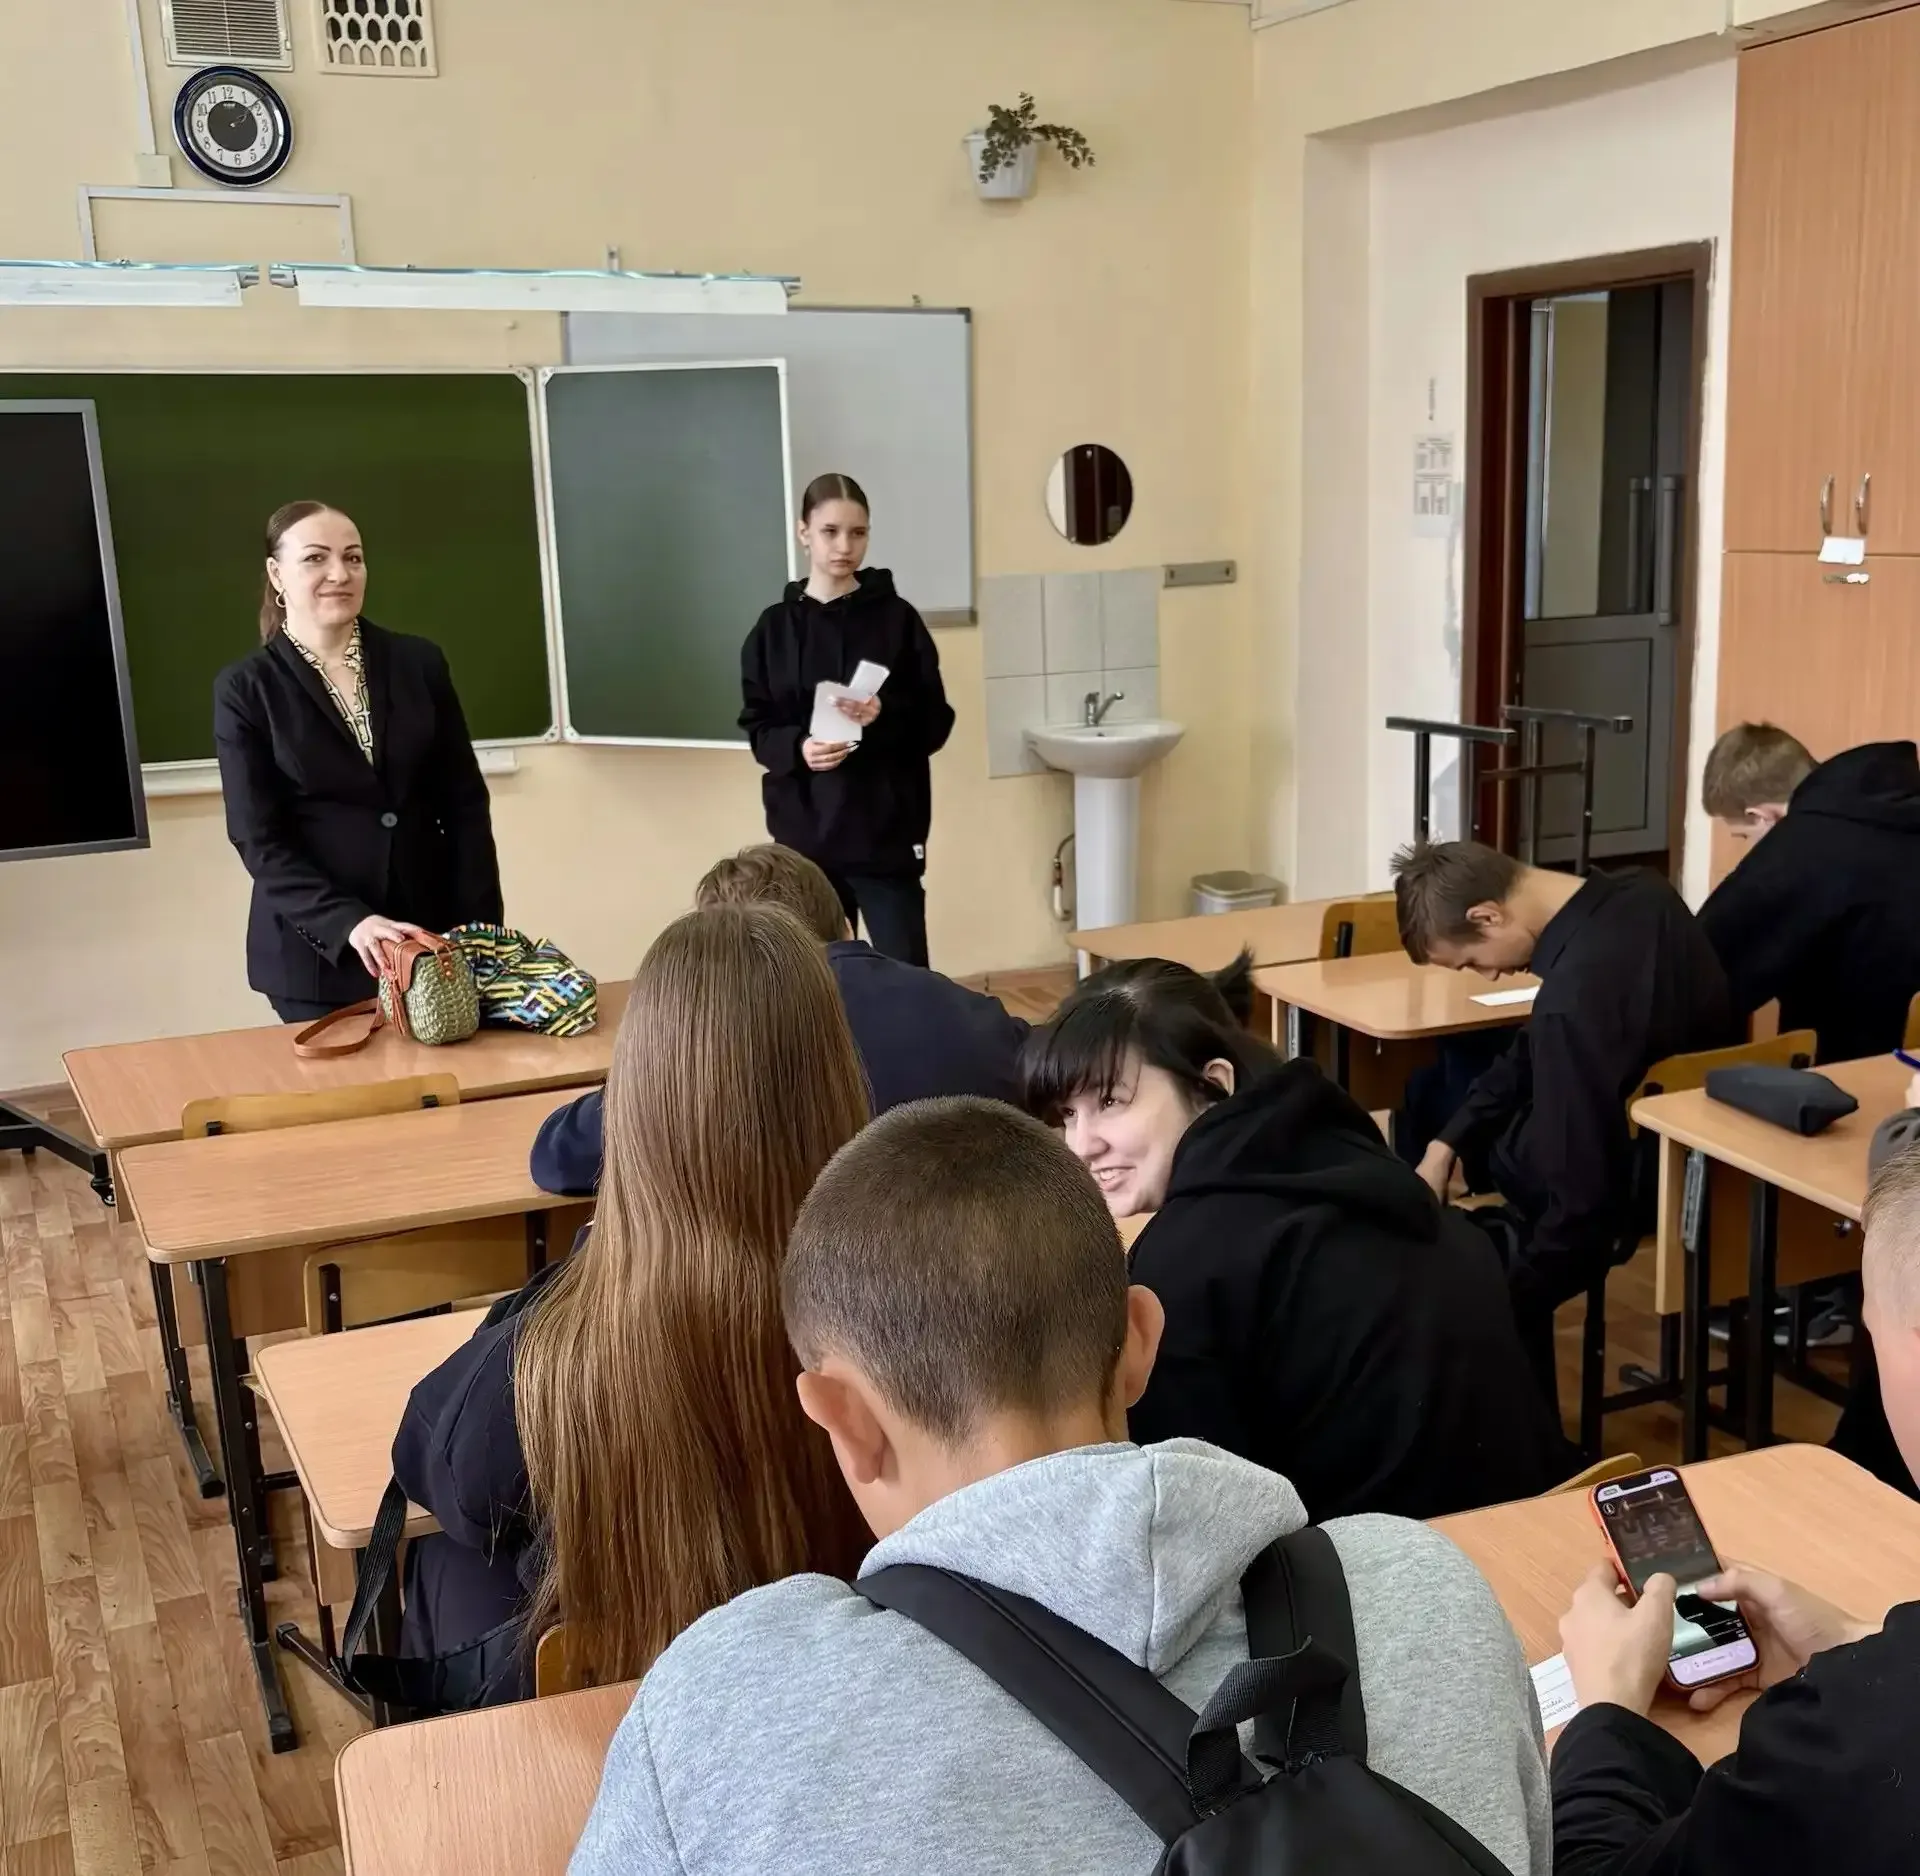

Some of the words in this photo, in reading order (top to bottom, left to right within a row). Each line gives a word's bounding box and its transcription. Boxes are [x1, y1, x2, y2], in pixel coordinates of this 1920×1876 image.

[207, 91, 217, 104] 11
[222, 87, 234, 99] 12
[242, 91, 247, 104] 1
[234, 154, 241, 166] 6
